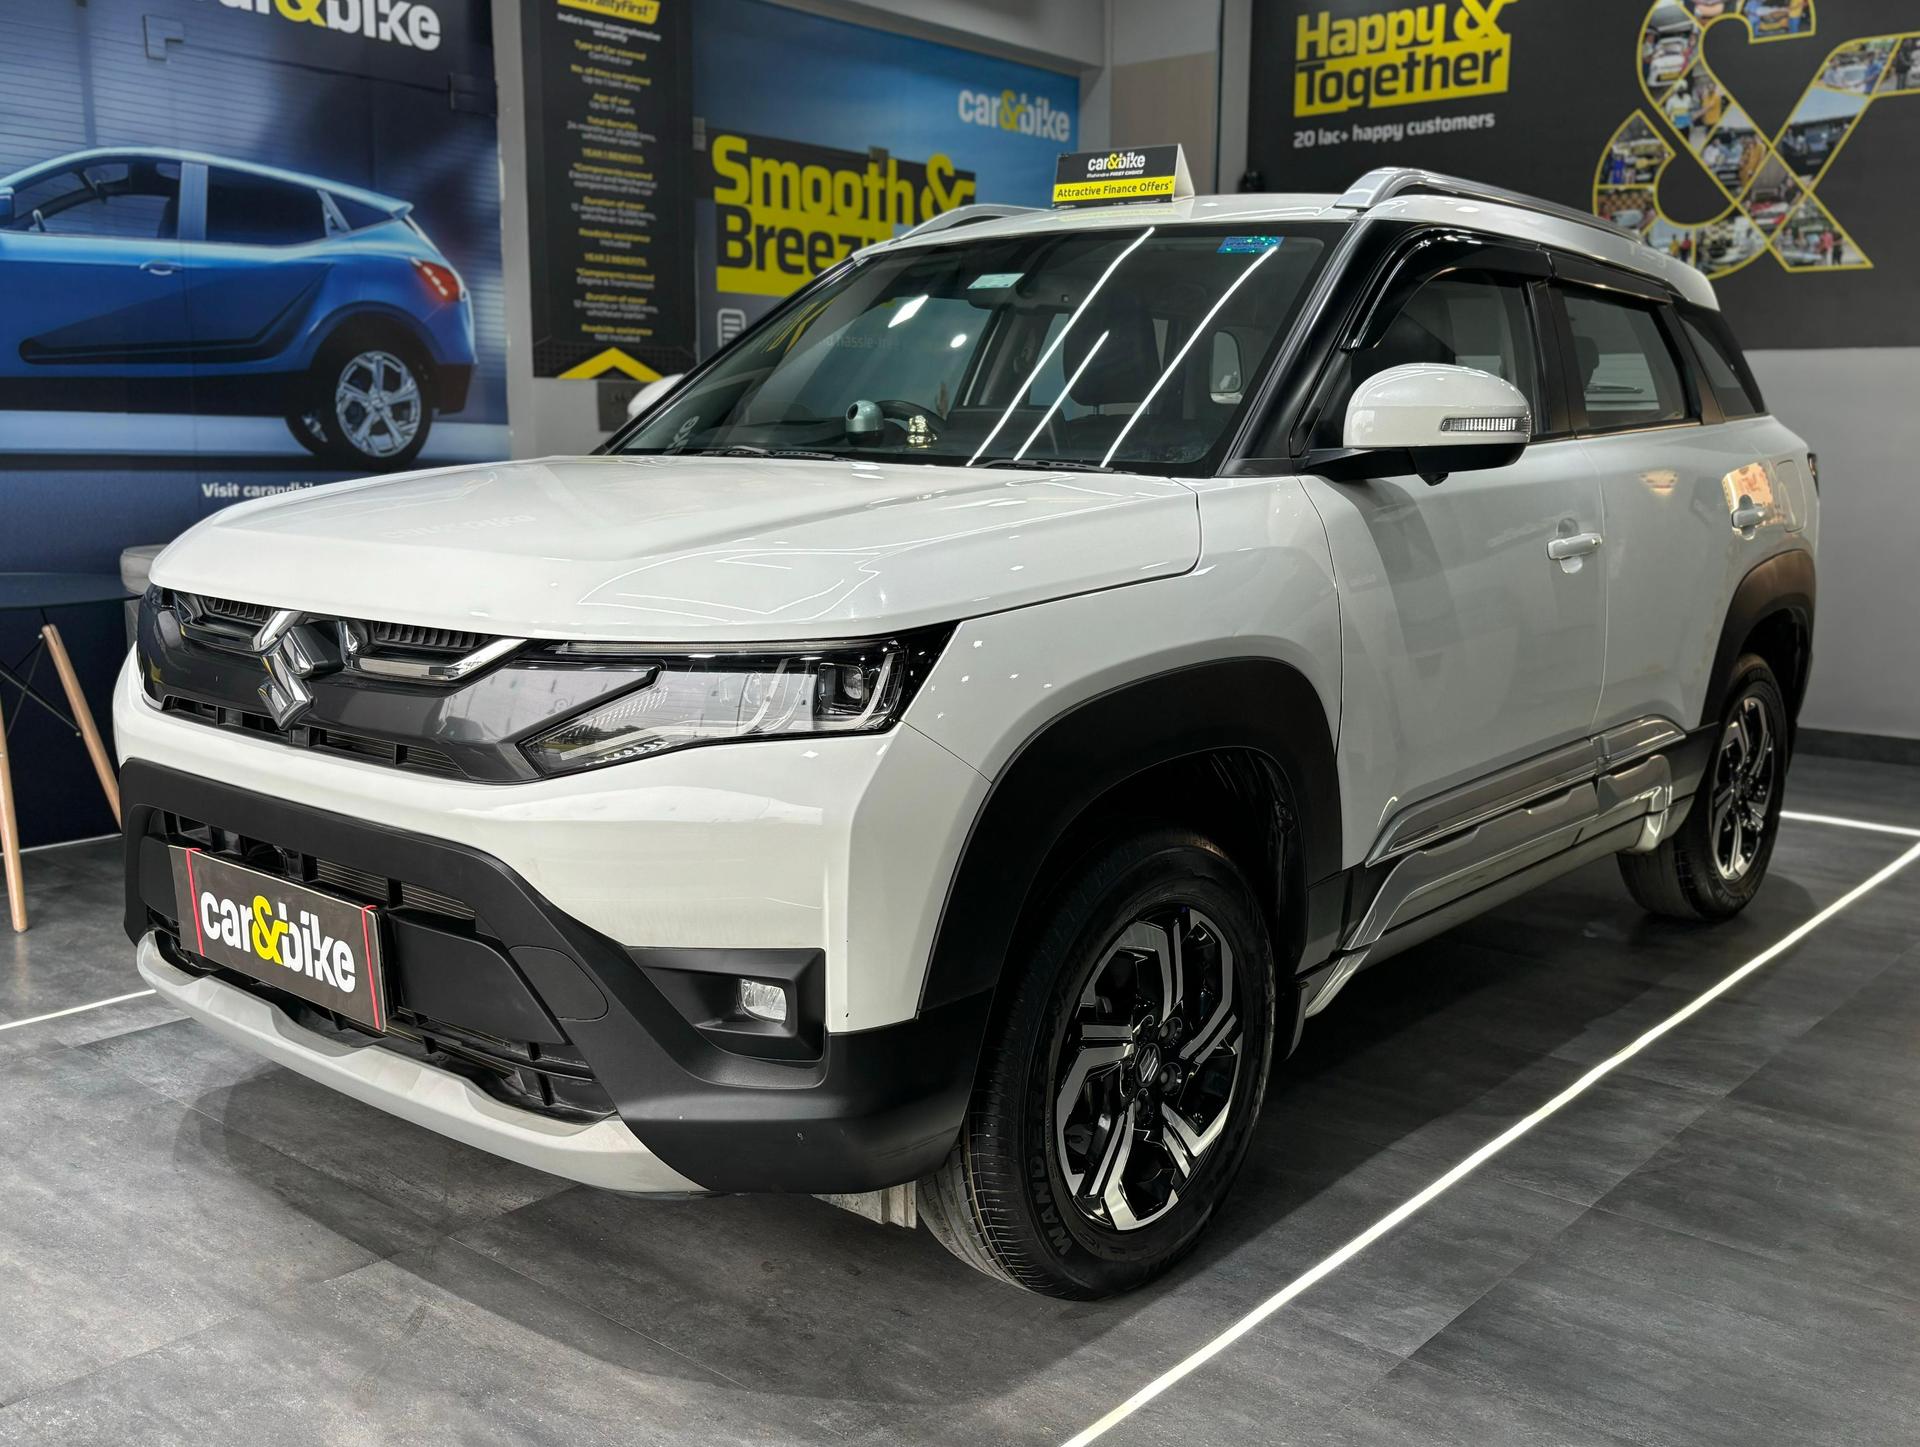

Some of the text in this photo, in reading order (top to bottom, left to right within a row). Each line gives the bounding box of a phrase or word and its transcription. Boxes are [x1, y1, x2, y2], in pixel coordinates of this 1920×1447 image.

[217, 0, 441, 51] bike
[1296, 3, 1447, 61] Happy
[1296, 48, 1503, 108] Together
[958, 89, 1070, 142] car&bike
[1293, 112, 1495, 148] 20 lac+ happy customers
[712, 134, 976, 225] Smooth &
[1088, 151, 1146, 171] car&bike
[1057, 186, 1101, 198] Attractive
[1103, 183, 1137, 194] Finance
[717, 202, 877, 276] Breez
[202, 482, 239, 498] Visit
[200, 891, 356, 993] car&bike
